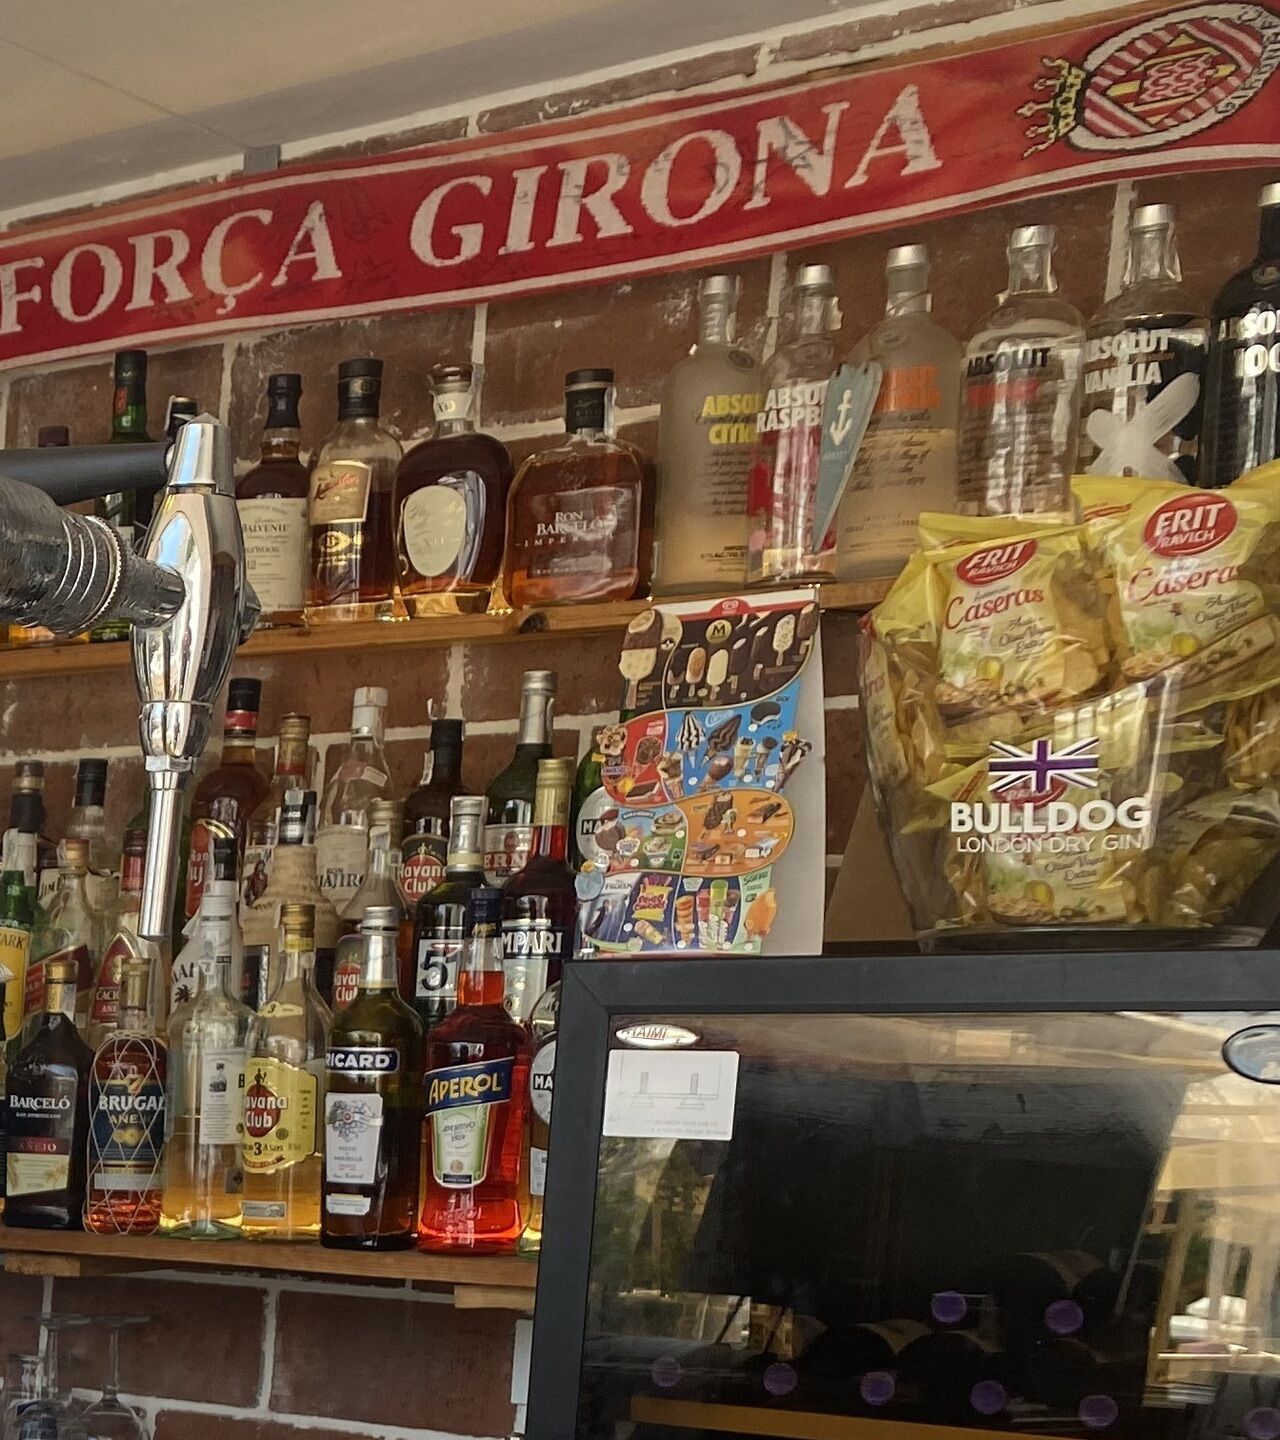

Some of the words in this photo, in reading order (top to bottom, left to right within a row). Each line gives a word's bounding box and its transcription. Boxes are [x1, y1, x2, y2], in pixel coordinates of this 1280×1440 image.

[409, 82, 949, 269] GIRONA
[1086, 328, 1175, 362] ABSOLUT
[966, 347, 1051, 377] ABSOLUT
[555, 511, 584, 521] RON
[1154, 502, 1227, 539] FRIT
[524, 531, 614, 548] IMPERL
[1158, 528, 1216, 549] RAVICH
[964, 540, 1030, 569] FRIT
[968, 558, 1019, 578] RAVICH
[944, 588, 1045, 630] Caseras
[950, 796, 1152, 834] BULLDOG
[957, 836, 1041, 853] LONDON
[1049, 836, 1096, 853] DRY
[1102, 835, 1142, 850] GIN
[484, 851, 527, 868] ERN
[502, 931, 564, 954] MPARI
[326, 1053, 391, 1068] RICARD
[429, 1073, 503, 1105] APEROL
[10, 1095, 71, 1111] BARCELÓ
[98, 1094, 166, 1111] BRUGAL
[18, 1140, 57, 1152] AÑEJO
[254, 1141, 263, 1156] 3
